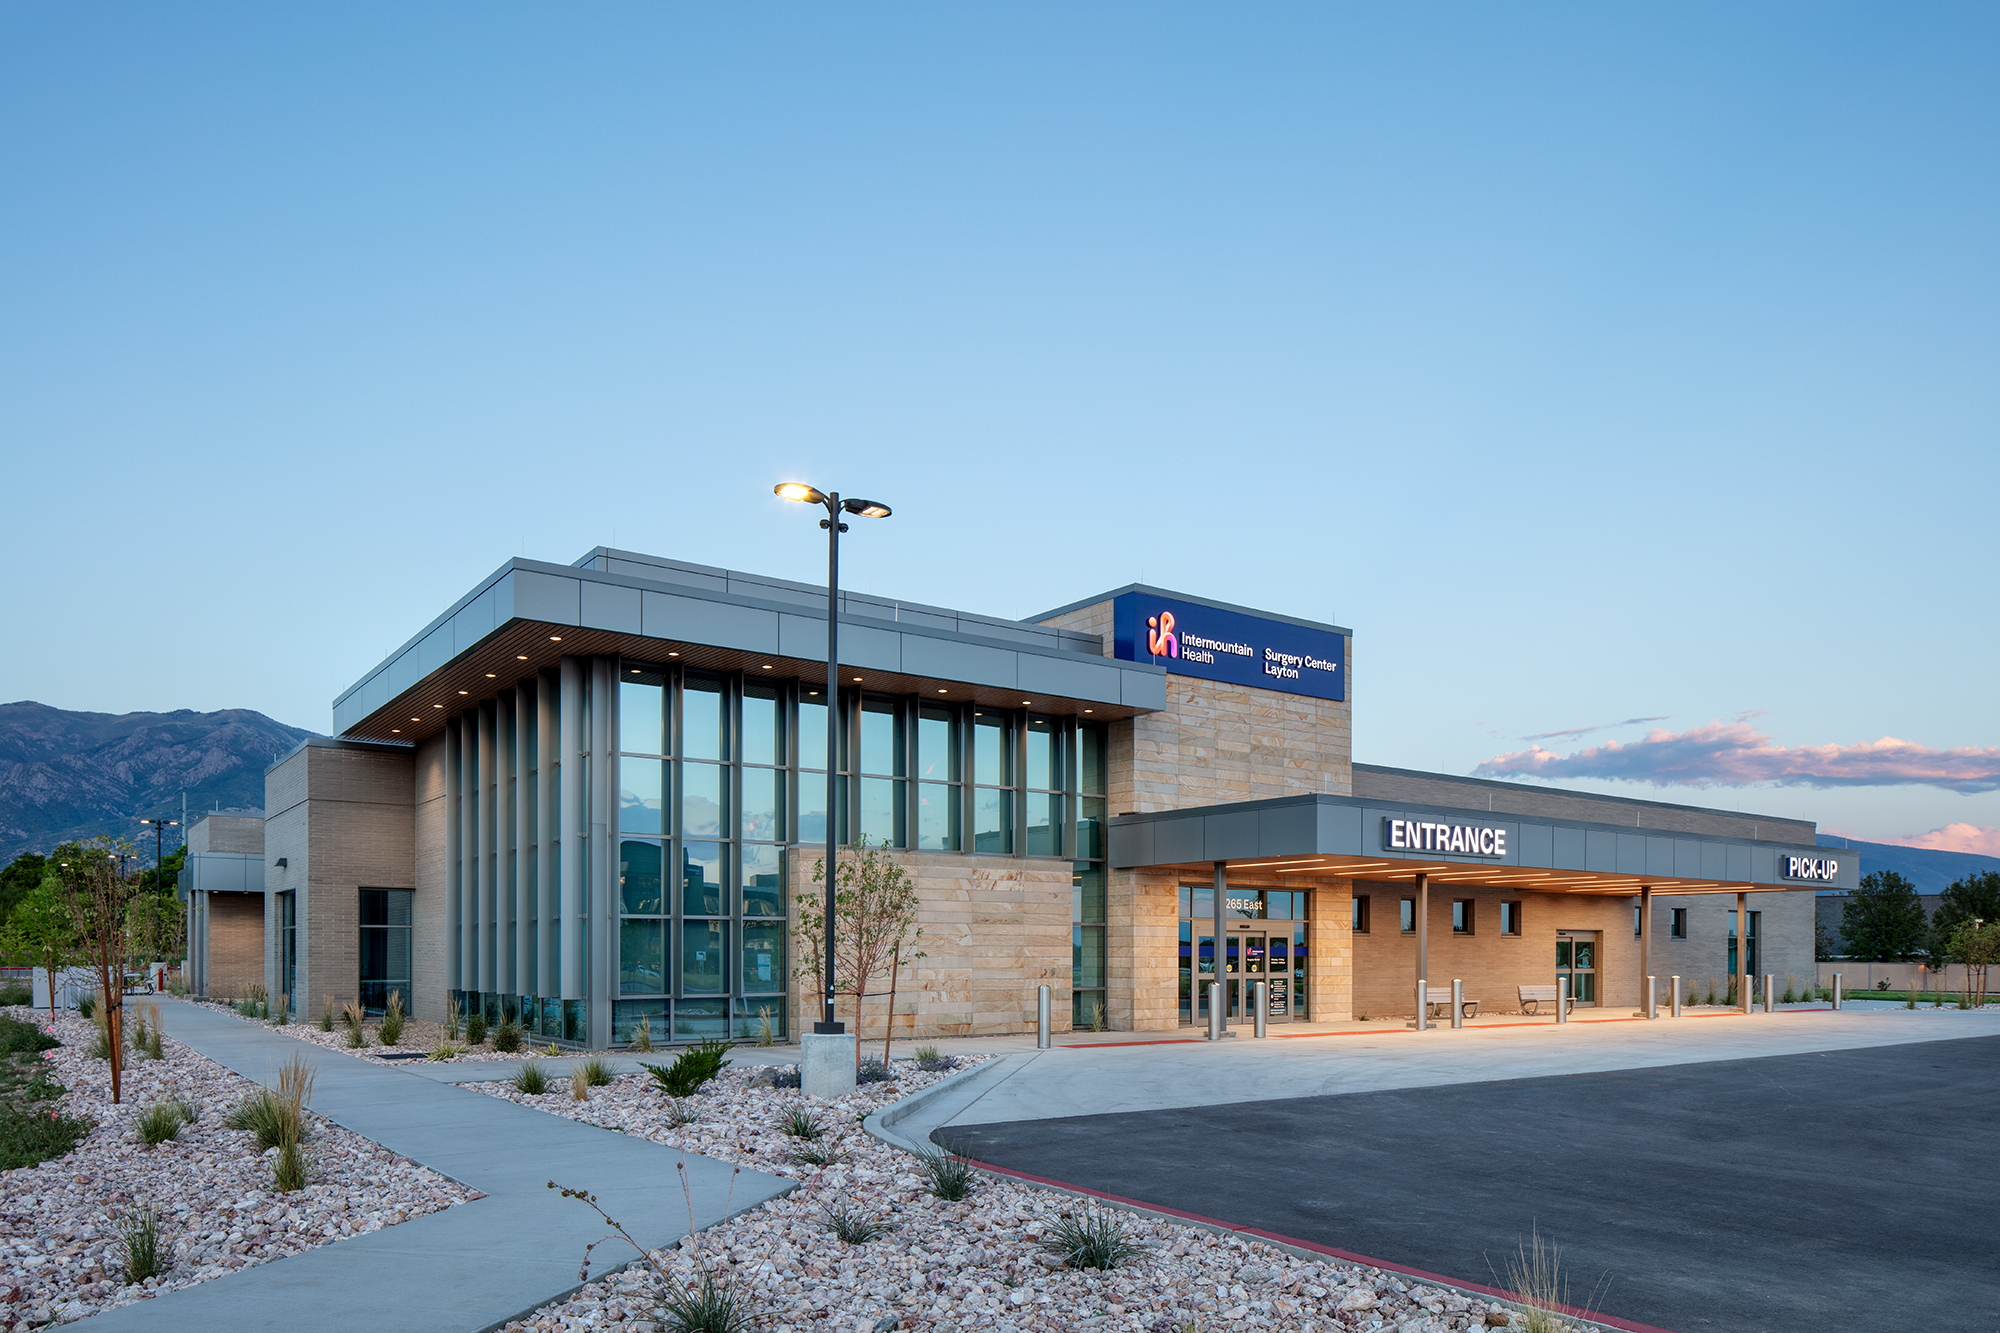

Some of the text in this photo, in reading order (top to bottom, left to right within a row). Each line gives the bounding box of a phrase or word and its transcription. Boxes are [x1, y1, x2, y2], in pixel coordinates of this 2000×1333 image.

[1181, 632, 1254, 657] Intermountain
[1182, 647, 1214, 664] Health
[1265, 648, 1337, 672] Surgery Center
[1265, 662, 1299, 680] Layton
[1391, 819, 1507, 855] ENTRANCE
[1789, 856, 1838, 880] PICK-UP
[1243, 898, 1263, 910] East
